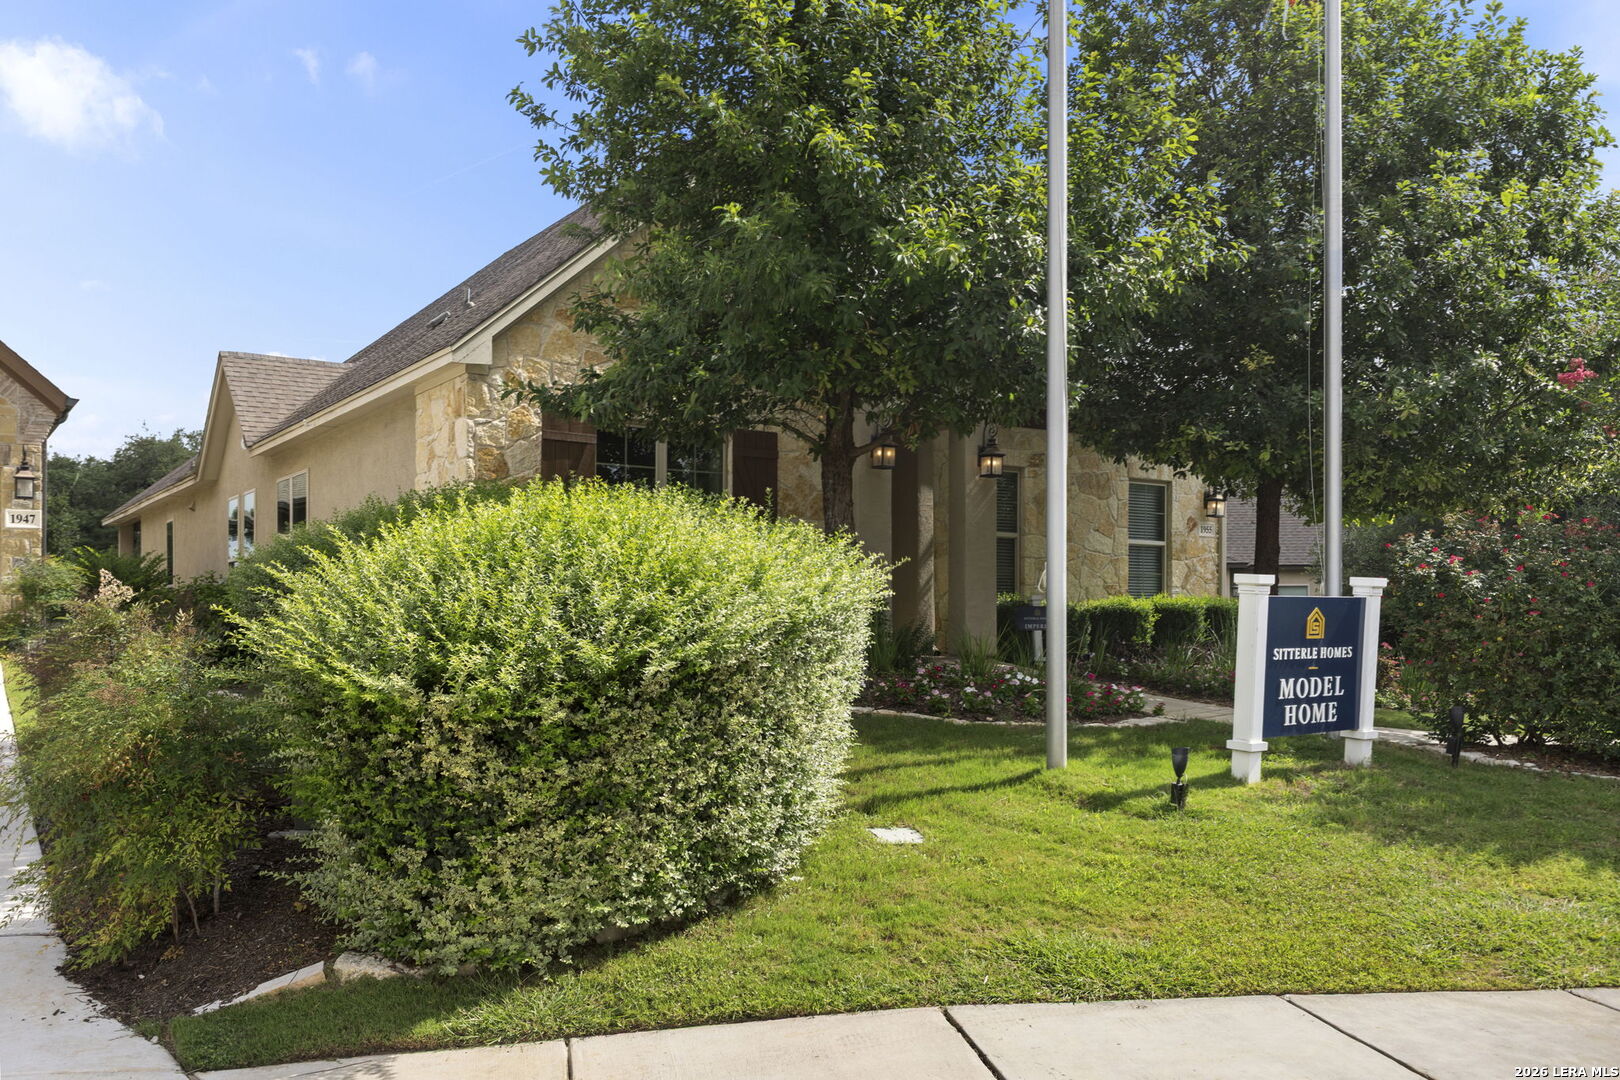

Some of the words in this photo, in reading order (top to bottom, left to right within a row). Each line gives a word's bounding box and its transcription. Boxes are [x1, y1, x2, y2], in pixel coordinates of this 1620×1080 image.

[10, 513, 36, 524] 1947
[1272, 647, 1318, 661] SITTERLE
[1319, 646, 1353, 659] HOMES
[1278, 675, 1345, 700] MODEL
[1283, 701, 1338, 726] HOME
